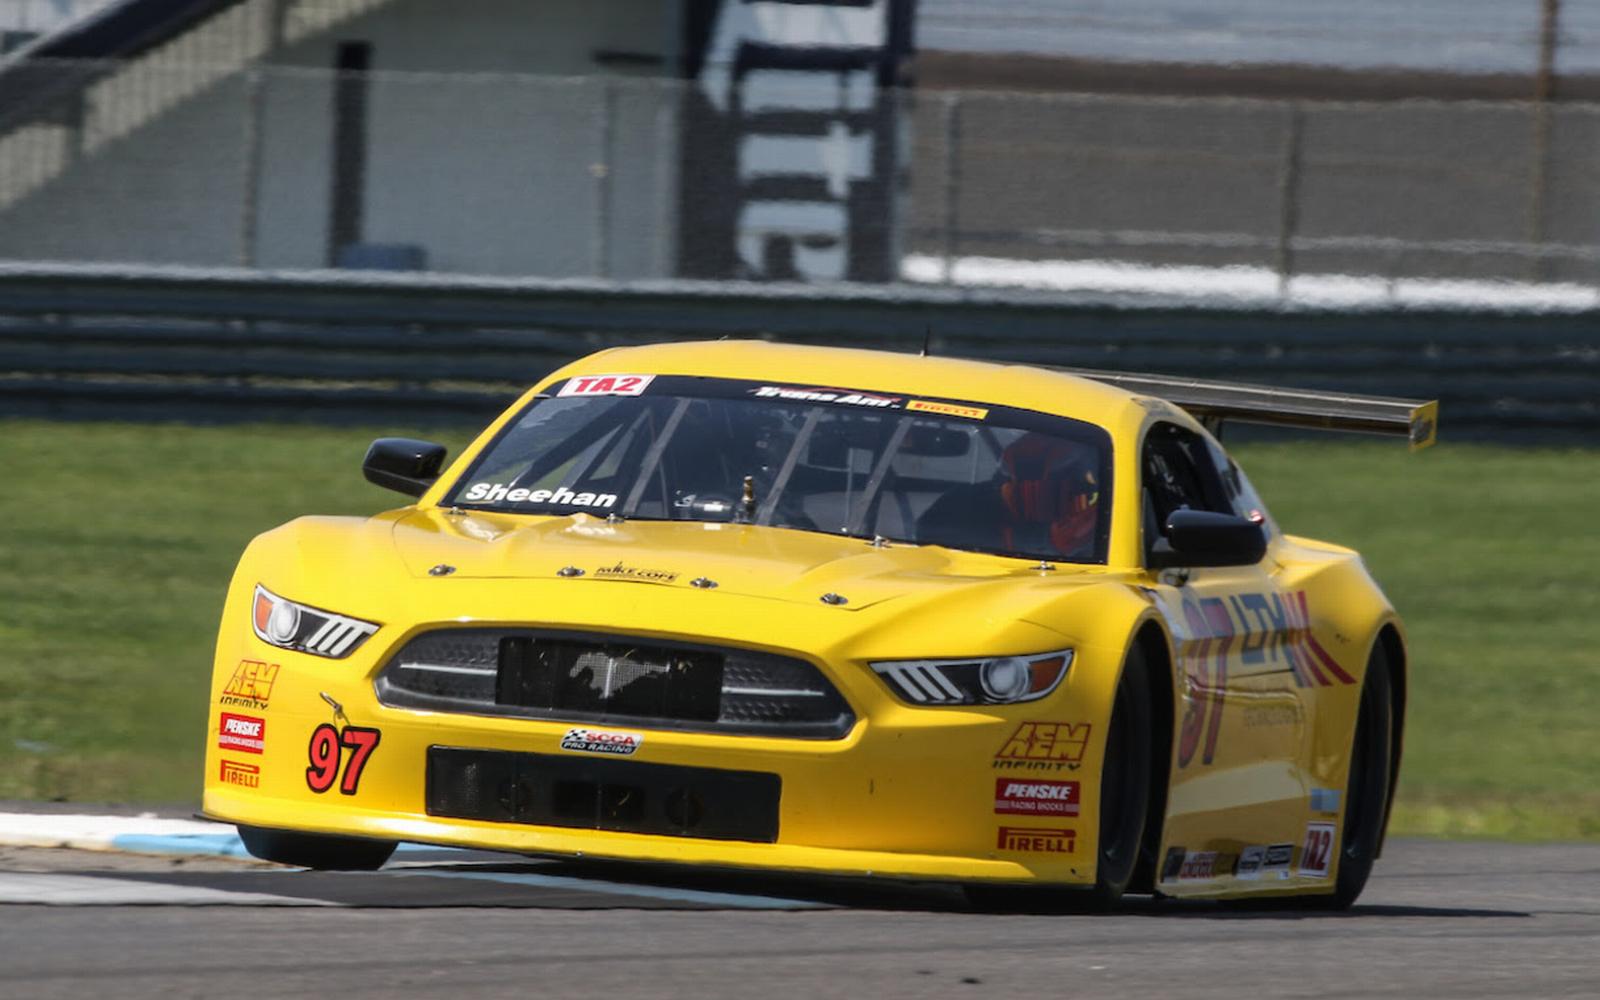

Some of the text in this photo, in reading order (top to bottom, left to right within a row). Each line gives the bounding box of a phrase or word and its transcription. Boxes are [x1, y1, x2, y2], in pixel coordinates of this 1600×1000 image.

[574, 377, 643, 393] TA2
[755, 386, 837, 400] Trans
[914, 402, 977, 416] PIRELLI
[465, 483, 617, 507] Sheehan
[220, 695, 268, 710] INFINITY
[225, 718, 262, 737] PENSKE
[563, 741, 633, 753] PRO RACING
[586, 733, 635, 745] SCCA
[995, 721, 1092, 761] AEM
[306, 723, 382, 796] 97
[992, 760, 1081, 771] INFINITY
[220, 759, 260, 788] PIRELLI
[1004, 783, 1072, 800] PENSKE
[1011, 801, 1036, 810] RACING
[998, 826, 1076, 853] PIRELLI
